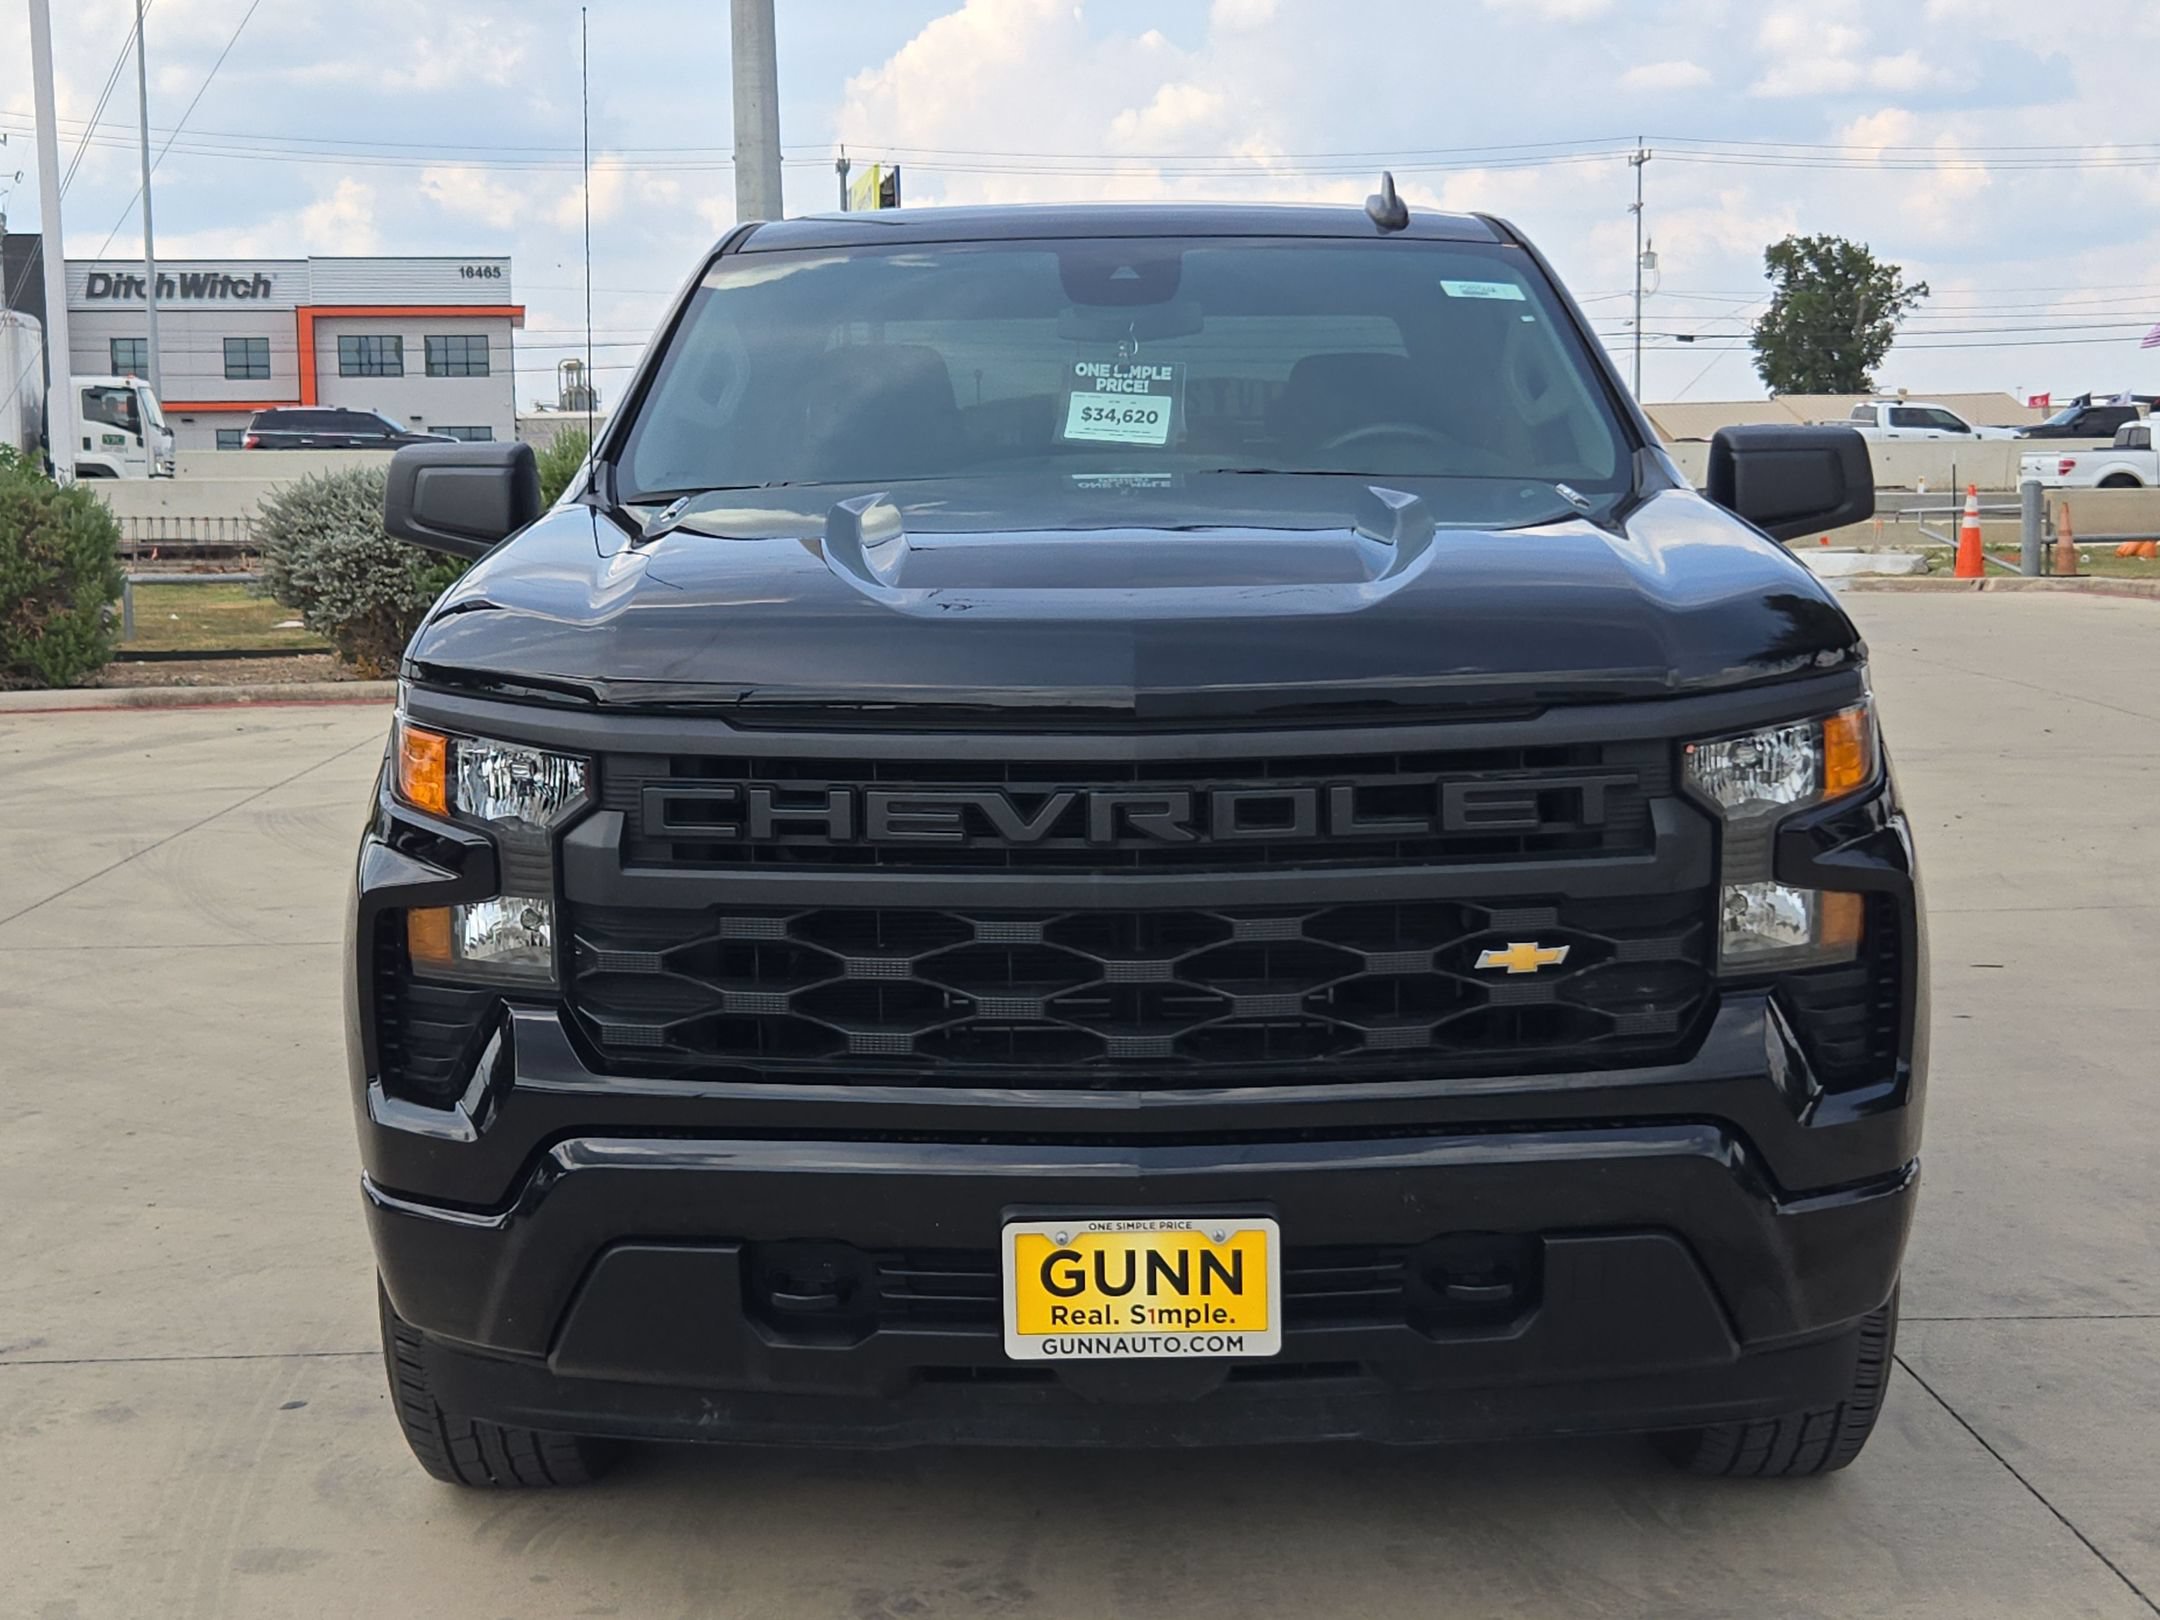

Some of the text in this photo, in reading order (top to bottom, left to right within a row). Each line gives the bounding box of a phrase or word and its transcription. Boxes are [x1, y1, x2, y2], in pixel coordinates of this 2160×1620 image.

[459, 265, 502, 279] 16465
[179, 272, 271, 299] Witch
[1075, 362, 1111, 377] ONE
[1096, 378, 1149, 393] PRICE!
[1081, 406, 1159, 425] $34,620
[641, 774, 1639, 843] CHEVROLET
[1088, 1221, 1192, 1231] ONE SIMPLE PRICE
[1040, 1248, 1243, 1297] GUNN
[1051, 1304, 1120, 1325] Real.
[1042, 1335, 1244, 1355] GUNNAUTO.COM
